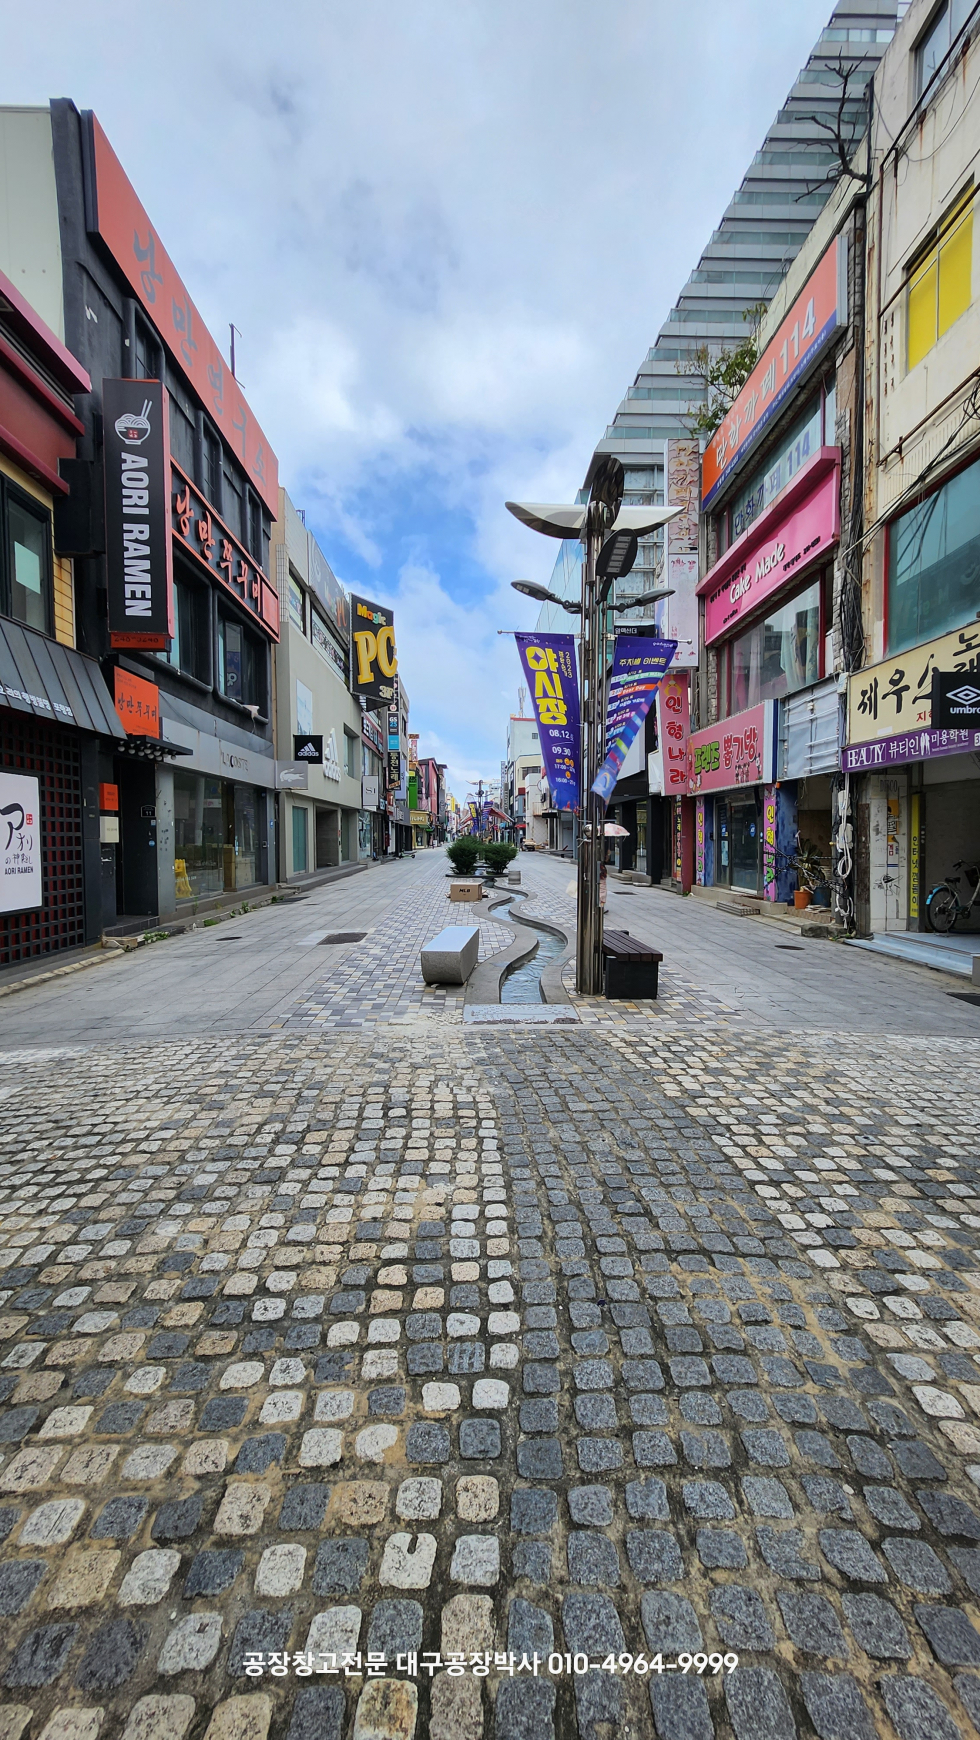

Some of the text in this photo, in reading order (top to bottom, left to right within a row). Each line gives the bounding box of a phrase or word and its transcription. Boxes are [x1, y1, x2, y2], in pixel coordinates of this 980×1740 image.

[133, 228, 267, 487] 낭만연구소
[780, 296, 816, 376] 114
[787, 431, 810, 477] 114
[121, 452, 152, 616] AORI RAMEN
[175, 484, 261, 613] 낭만쭈꾸미
[729, 574, 752, 604] Cake
[754, 543, 785, 583] Made
[356, 603, 387, 626] Magic
[353, 626, 398, 685] PC
[643, 657, 666, 665] 이벤트
[525, 646, 567, 725] 야시장
[549, 729, 569, 739] 08.12
[552, 747, 571, 756] 09.30
[665, 695, 687, 785] 인형나라
[694, 725, 758, 775] 프렌즈 뽑기방
[847, 743, 887, 768] BEAUTY
[889, 729, 969, 759] 뷰티인 미용학원
[4, 866, 34, 875] AORI RAMEN
